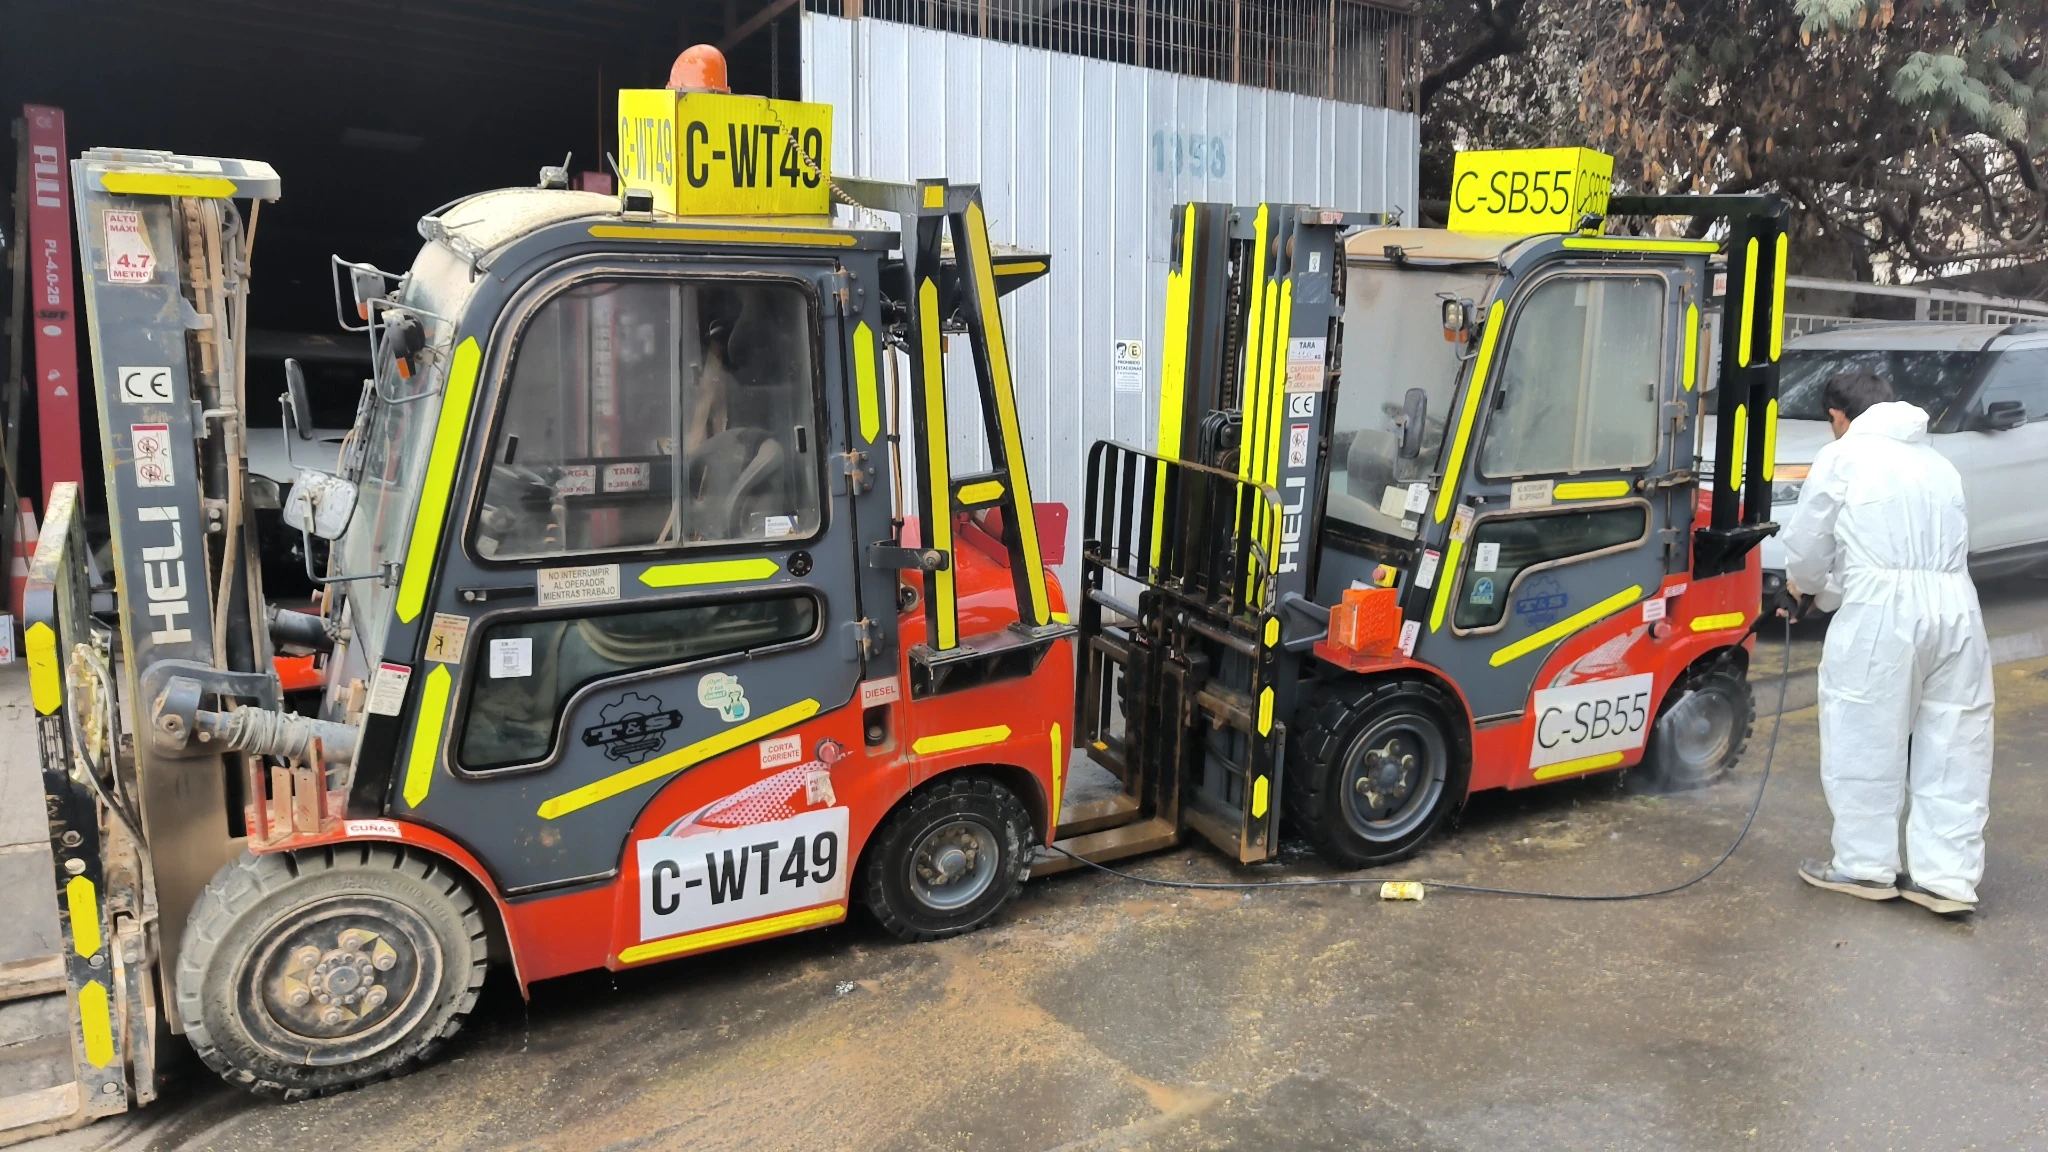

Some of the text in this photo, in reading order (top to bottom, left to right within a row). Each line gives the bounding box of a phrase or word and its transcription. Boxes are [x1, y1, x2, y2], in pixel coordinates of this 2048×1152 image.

[621, 116, 673, 187] C-WT49
[686, 120, 823, 189] C-WT49
[1455, 170, 1571, 215] C-SB55
[117, 253, 150, 268] 4.7
[1299, 341, 1316, 349] TARA
[125, 372, 168, 398] CE
[1292, 395, 1313, 414] CE
[613, 467, 640, 476] TARA
[1278, 476, 1307, 574] HELI
[138, 506, 192, 645] HELI
[548, 567, 610, 580] NO INTERRUMPIR
[553, 577, 605, 590] AL OPERADOR
[543, 586, 616, 600] MIENTRAS TRABAJO
[865, 685, 896, 699] DIESEL
[590, 713, 673, 742] T&S
[1537, 692, 1648, 748] C-SB55
[768, 742, 794, 753] CORTA
[762, 749, 800, 764] CORRIENTE
[350, 821, 396, 833] CUÑAS
[651, 830, 838, 916] C-WT49
